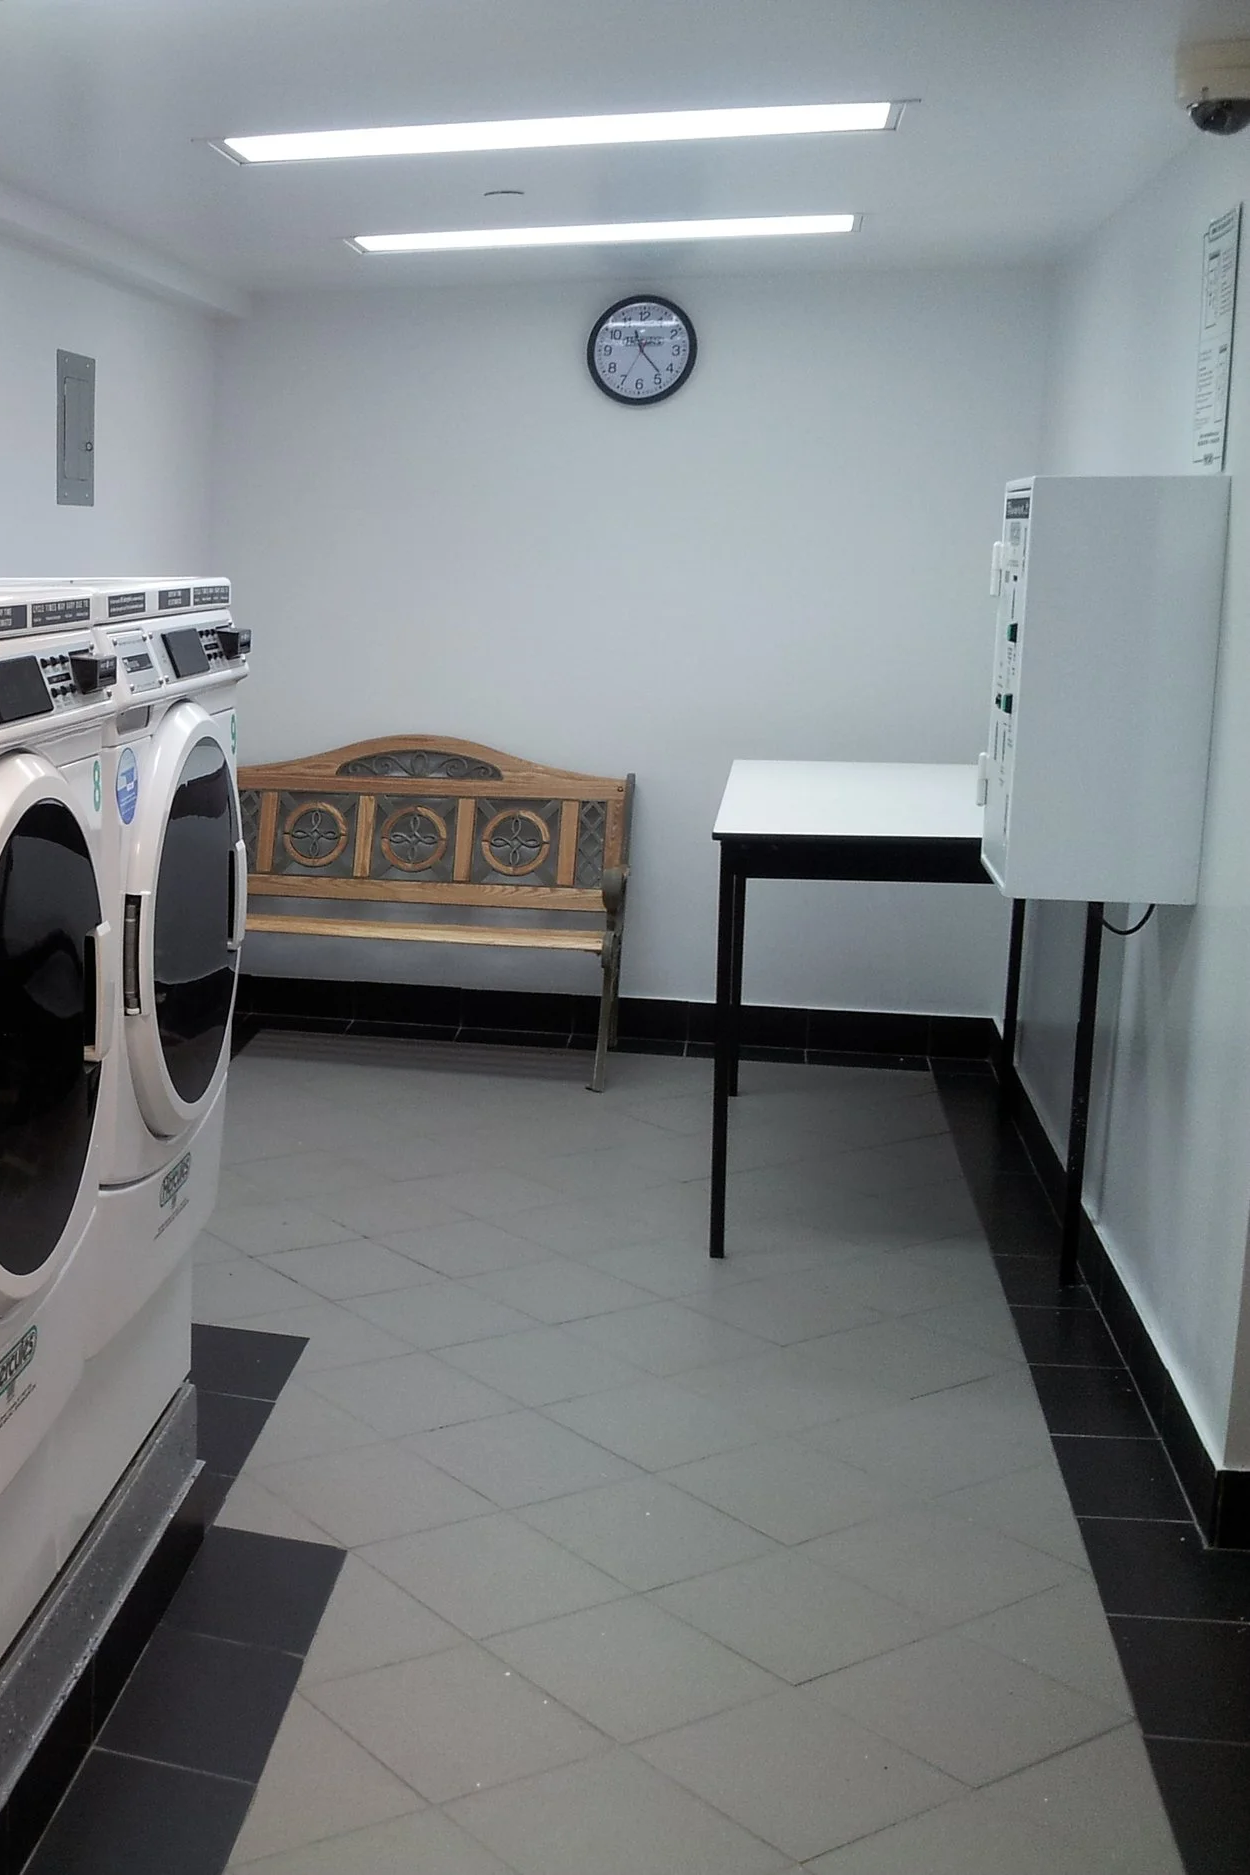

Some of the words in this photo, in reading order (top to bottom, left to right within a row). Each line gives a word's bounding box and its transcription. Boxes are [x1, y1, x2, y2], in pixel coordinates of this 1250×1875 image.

[640, 311, 651, 321] 12
[610, 330, 622, 340] 10
[670, 329, 678, 340] 2
[604, 345, 612, 356] 9
[672, 345, 680, 356] 3
[608, 362, 617, 373] 8
[666, 363, 674, 373] 4
[620, 375, 627, 385] 7
[635, 378, 644, 390] 6
[654, 374, 662, 385] 5
[93, 760, 100, 812] 8
